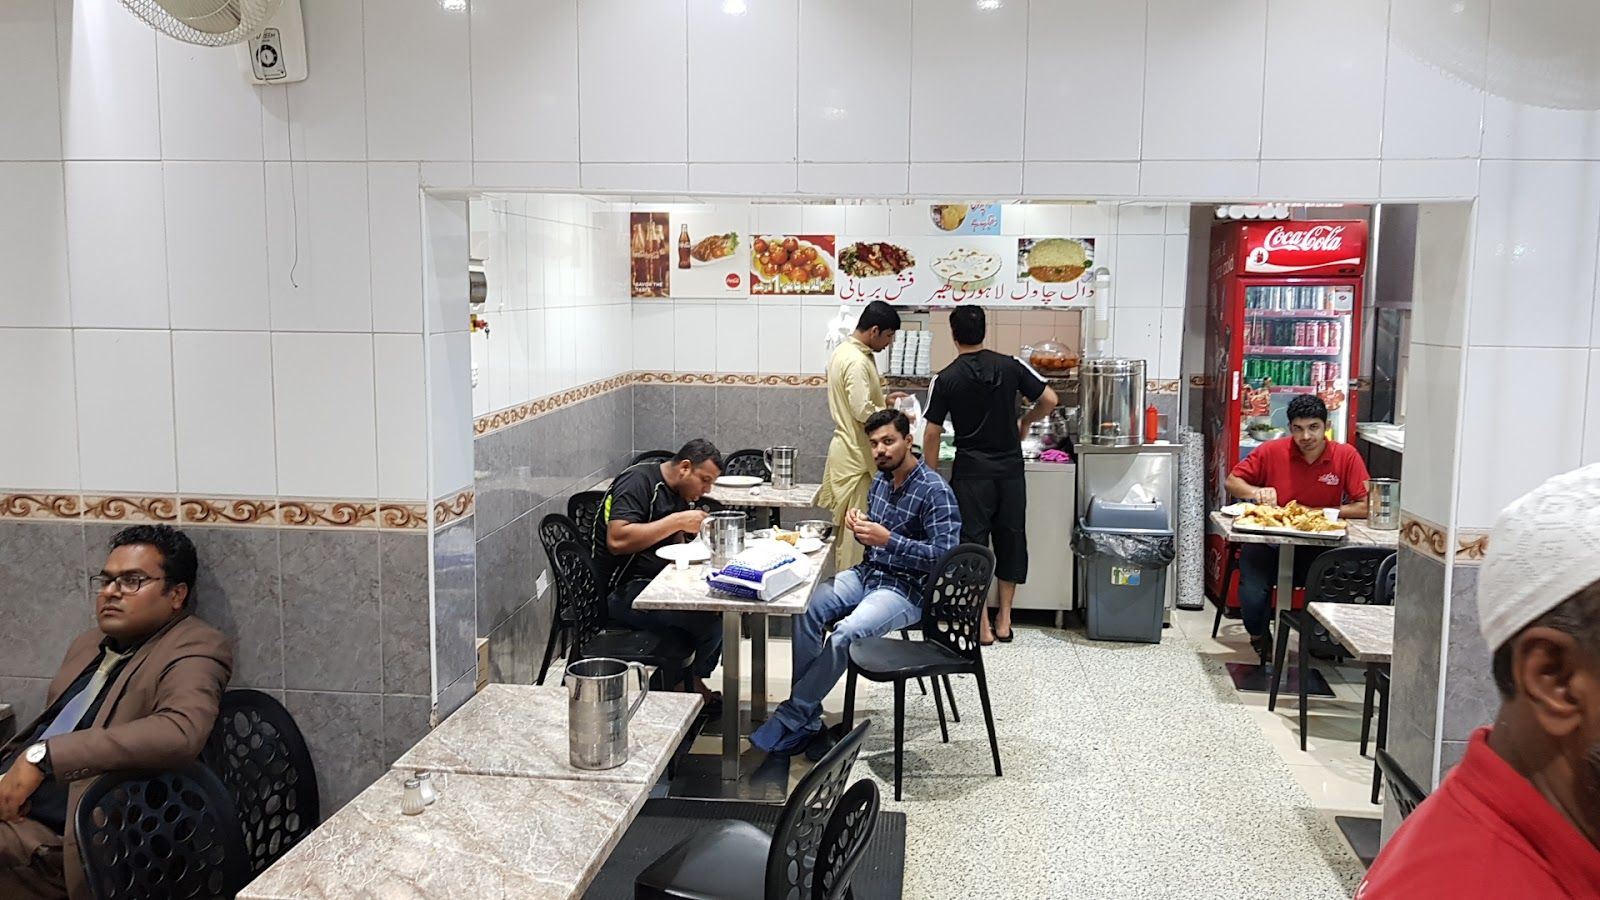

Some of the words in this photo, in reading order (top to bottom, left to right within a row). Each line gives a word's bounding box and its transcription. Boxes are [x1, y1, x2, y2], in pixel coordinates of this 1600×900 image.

[1264, 225, 1346, 252] Coca-Cola
[772, 273, 781, 293] 1
[839, 279, 881, 302] بریانی
[884, 272, 914, 300] فش
[952, 281, 1004, 302] لاہوری
[1010, 281, 1057, 304] چاول
[1060, 281, 1094, 300] دال
